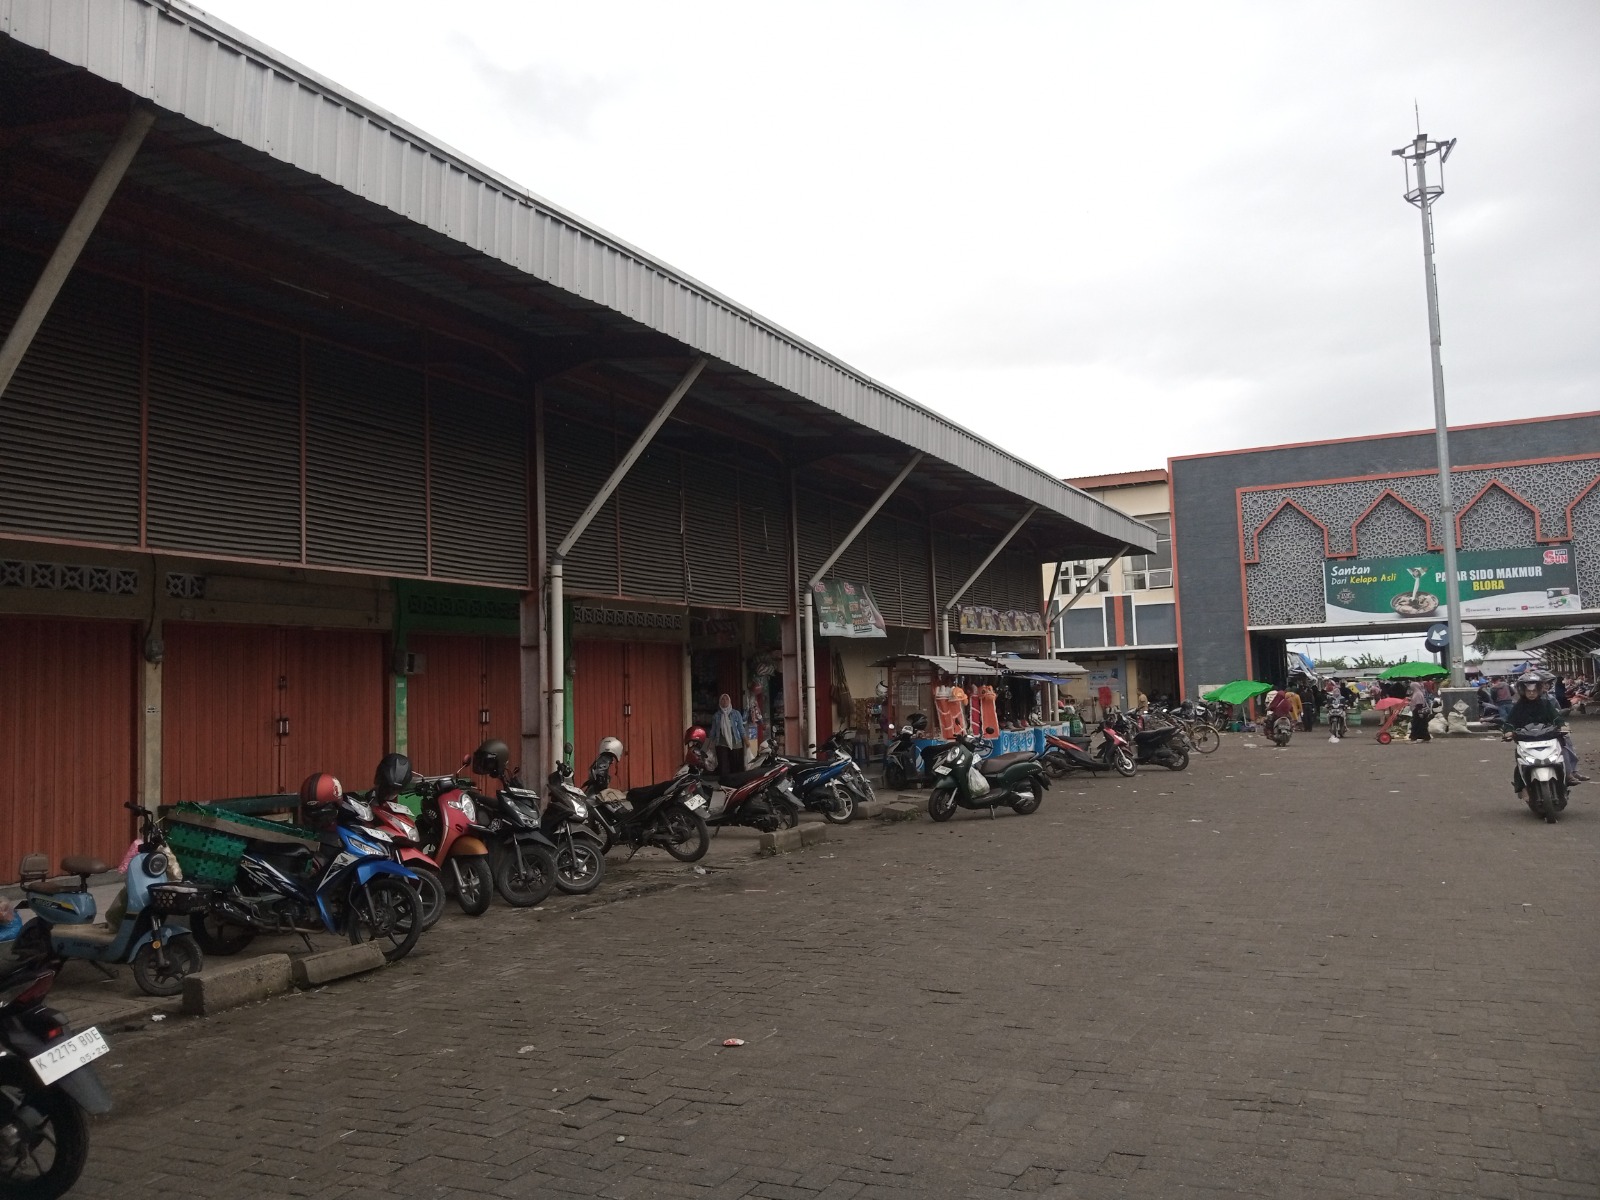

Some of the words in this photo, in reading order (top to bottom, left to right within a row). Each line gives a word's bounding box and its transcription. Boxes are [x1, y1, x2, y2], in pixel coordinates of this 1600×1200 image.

[1331, 565, 1370, 576] Santan
[1435, 571, 1467, 582] PAAR
[1469, 568, 1493, 581] SIDO
[1496, 566, 1542, 579] MAKMUR
[1331, 577, 1347, 585] Dari
[1350, 575, 1377, 585] Kelapa
[1381, 573, 1397, 582] Asli
[1472, 580, 1505, 591] BLORA
[36, 1058, 47, 1070] K
[48, 1041, 77, 1063] 2275
[79, 1030, 100, 1047] BDE
